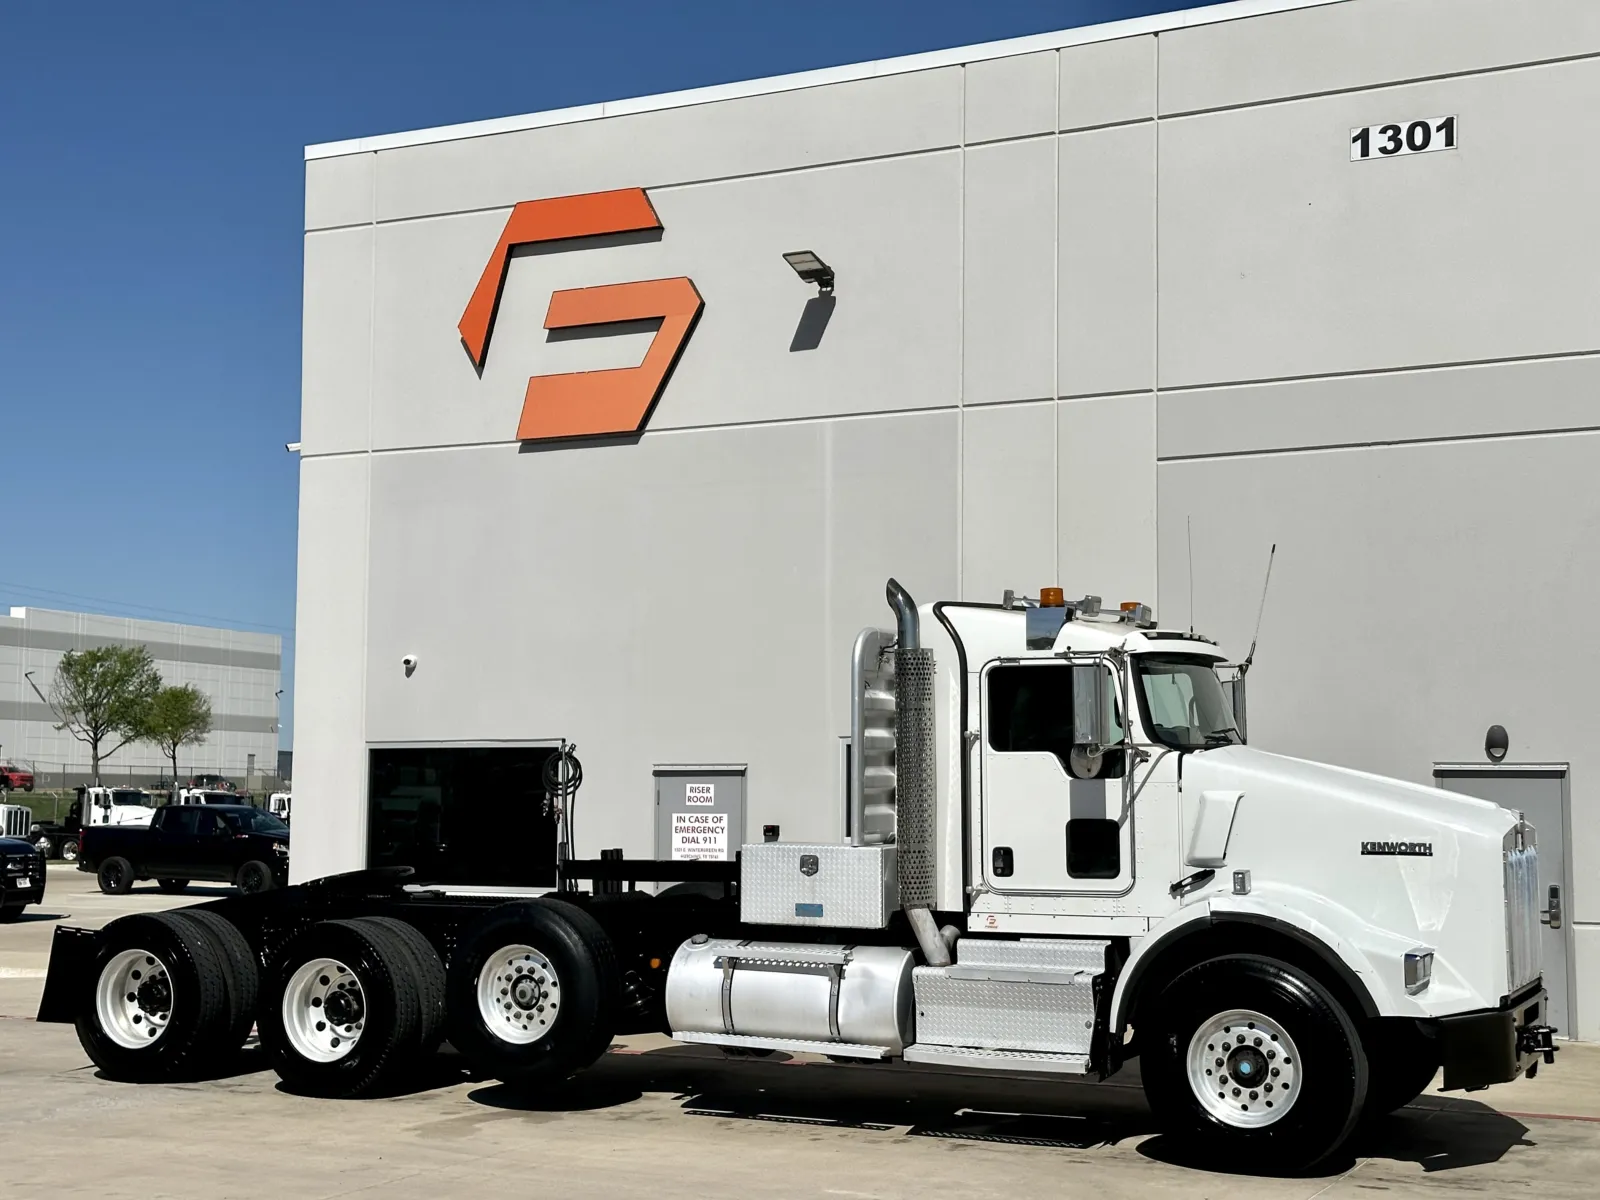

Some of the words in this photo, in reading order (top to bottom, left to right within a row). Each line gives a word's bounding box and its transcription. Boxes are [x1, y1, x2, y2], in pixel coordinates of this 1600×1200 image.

[1352, 116, 1455, 158] 1301
[689, 786, 711, 794] RISER
[687, 795, 713, 803] ROOM
[676, 815, 686, 823] IN
[688, 815, 709, 824] CASE
[711, 815, 724, 824] OF
[674, 825, 725, 834] EMERGENCY
[681, 836, 700, 844] DIAL
[702, 836, 717, 844] 911
[1361, 841, 1433, 854] KENWORTH
